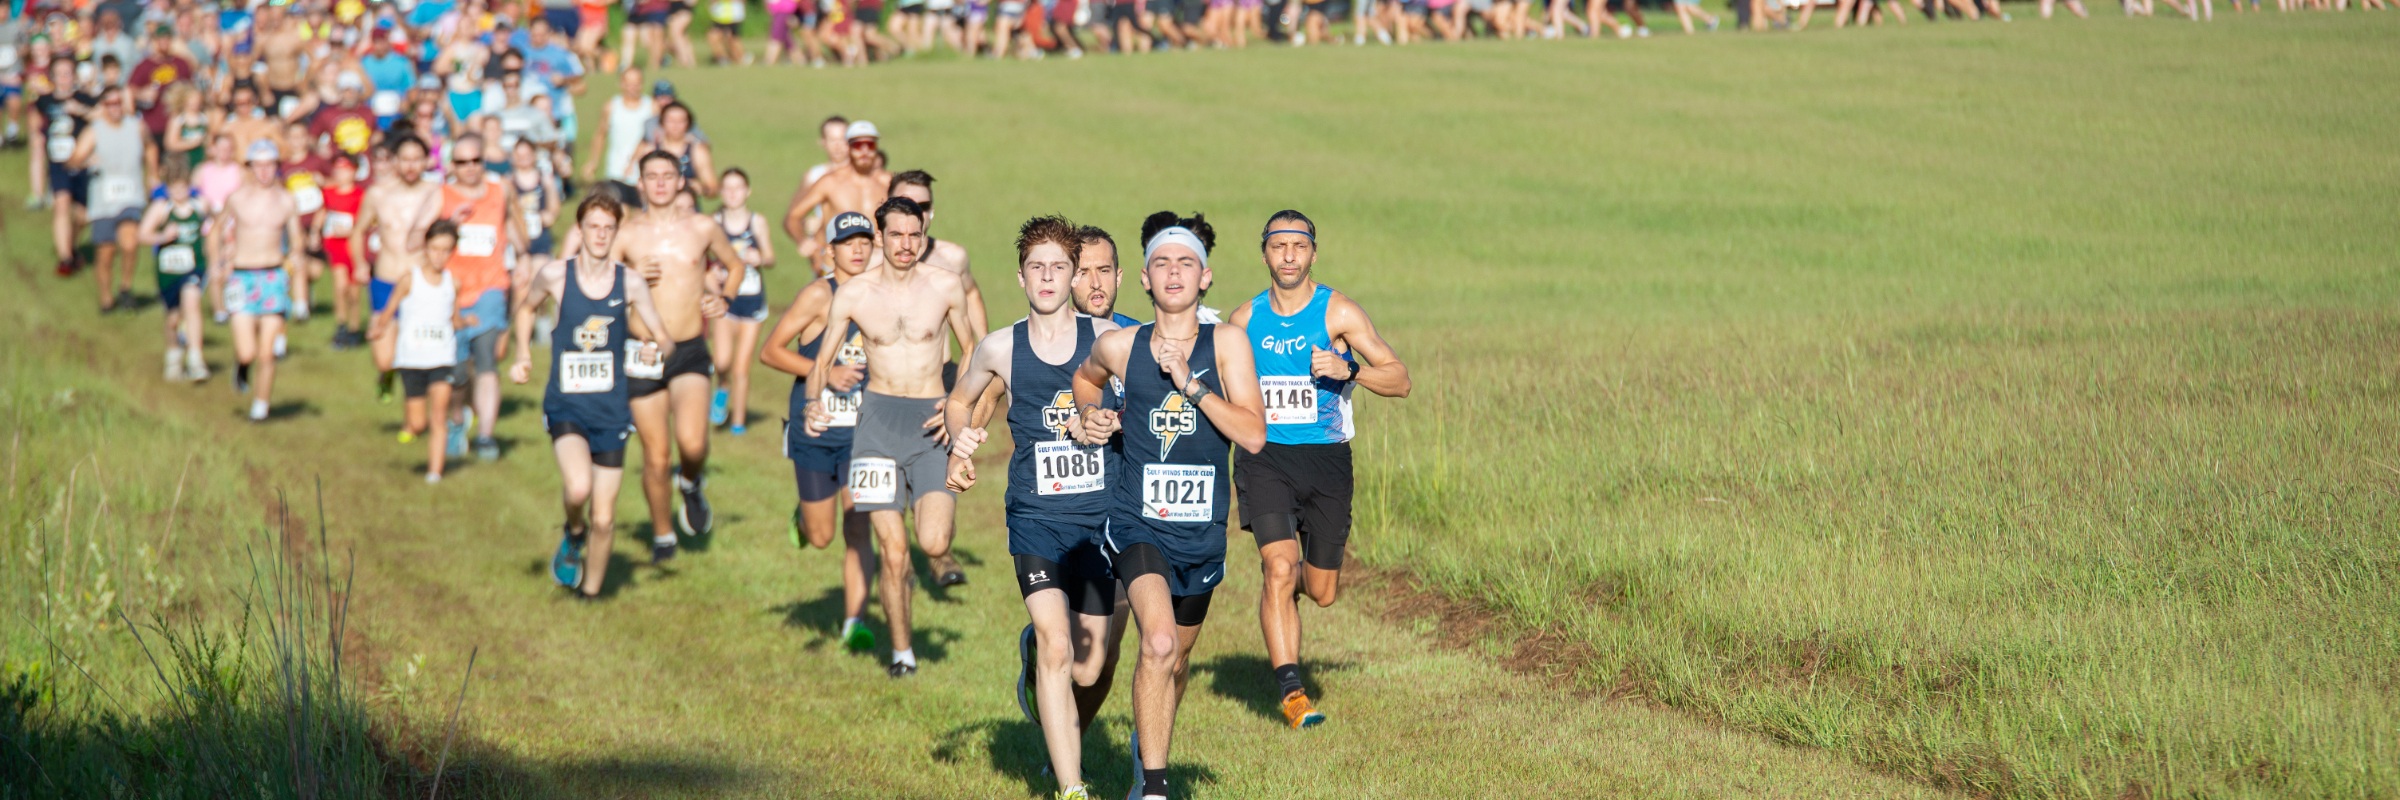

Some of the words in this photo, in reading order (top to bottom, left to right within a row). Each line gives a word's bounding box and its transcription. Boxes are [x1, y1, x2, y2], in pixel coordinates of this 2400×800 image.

[838, 214, 870, 229] ciele
[1261, 335, 1307, 355] GWTC
[568, 363, 609, 379] 1085
[1264, 389, 1313, 409] 1146
[1152, 411, 1194, 432] CCS
[1043, 453, 1100, 479] 1086
[851, 470, 892, 488] 1204
[1151, 479, 1207, 504] 1021
